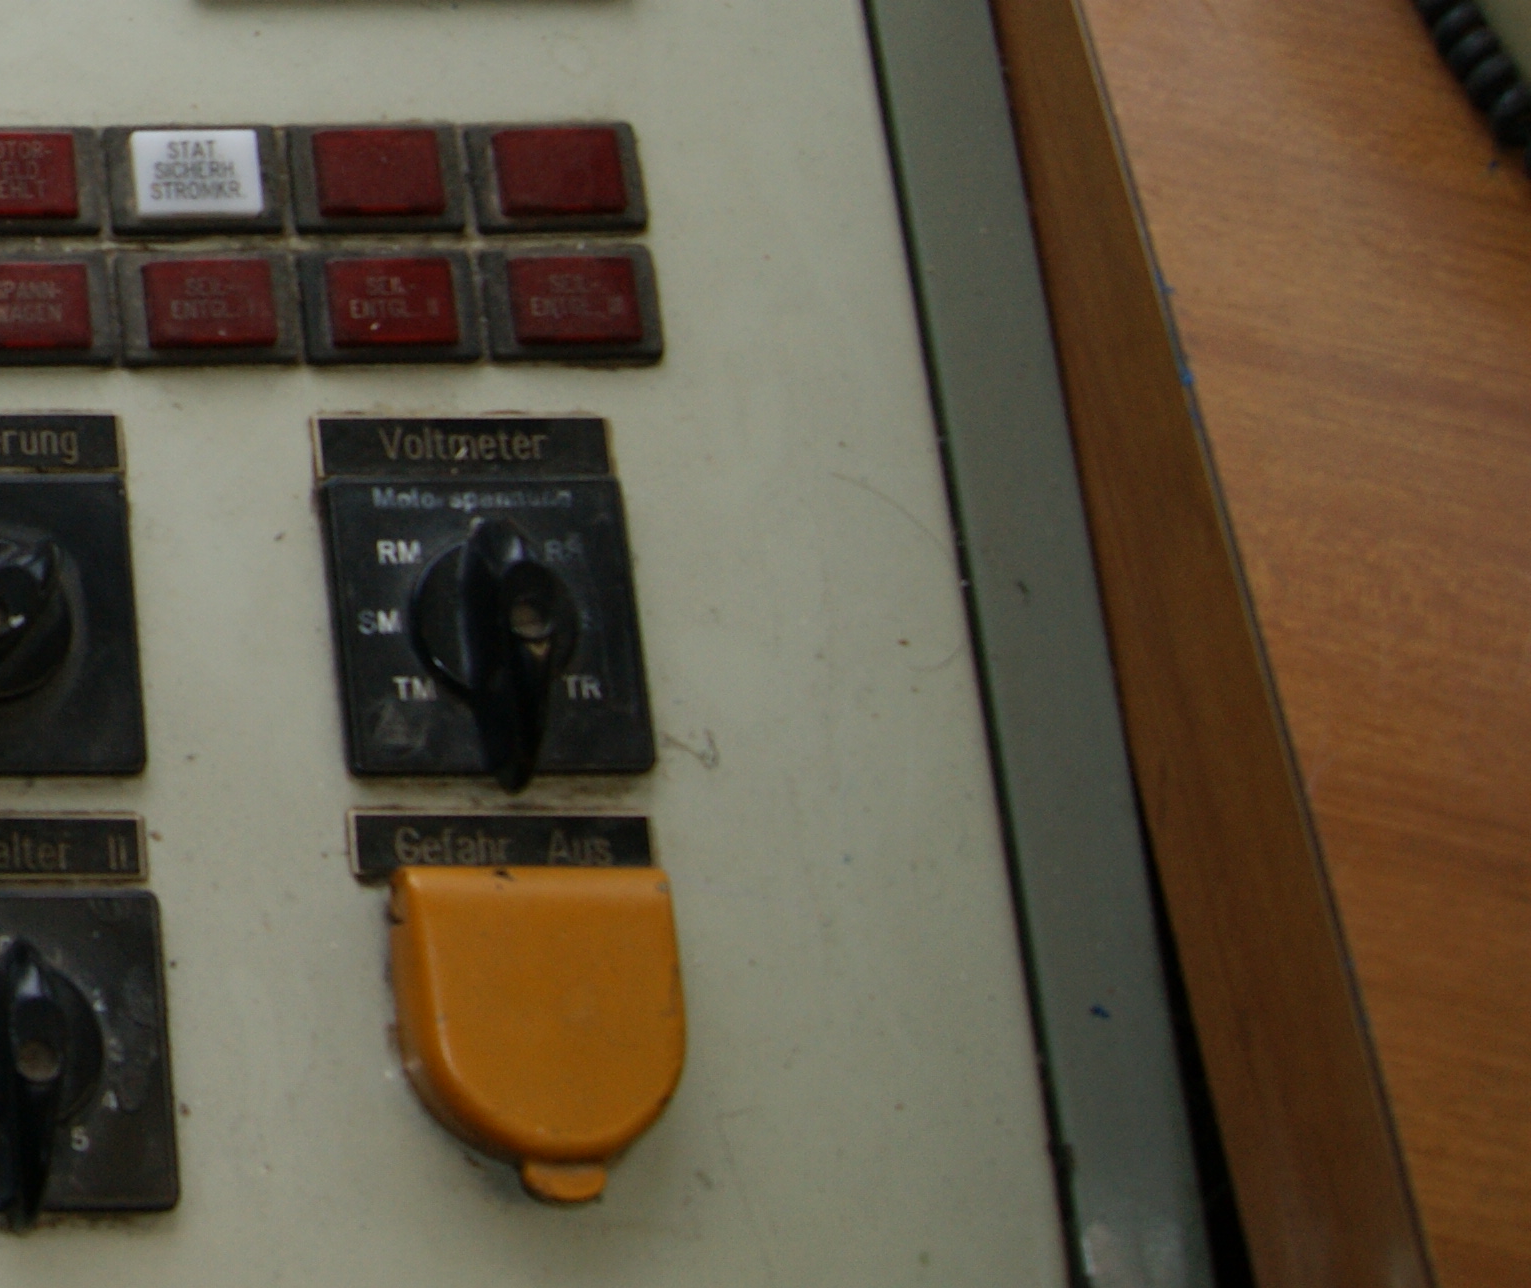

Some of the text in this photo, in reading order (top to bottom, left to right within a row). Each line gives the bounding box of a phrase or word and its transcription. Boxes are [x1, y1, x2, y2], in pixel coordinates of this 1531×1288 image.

[378, 425, 549, 461] Voltmeter
[377, 539, 422, 565] RM
[358, 609, 403, 636] SM
[392, 675, 438, 702] TM
[565, 674, 604, 700] TR
[394, 826, 612, 866] Gefahr Aus
[70, 1124, 91, 1152] 5
